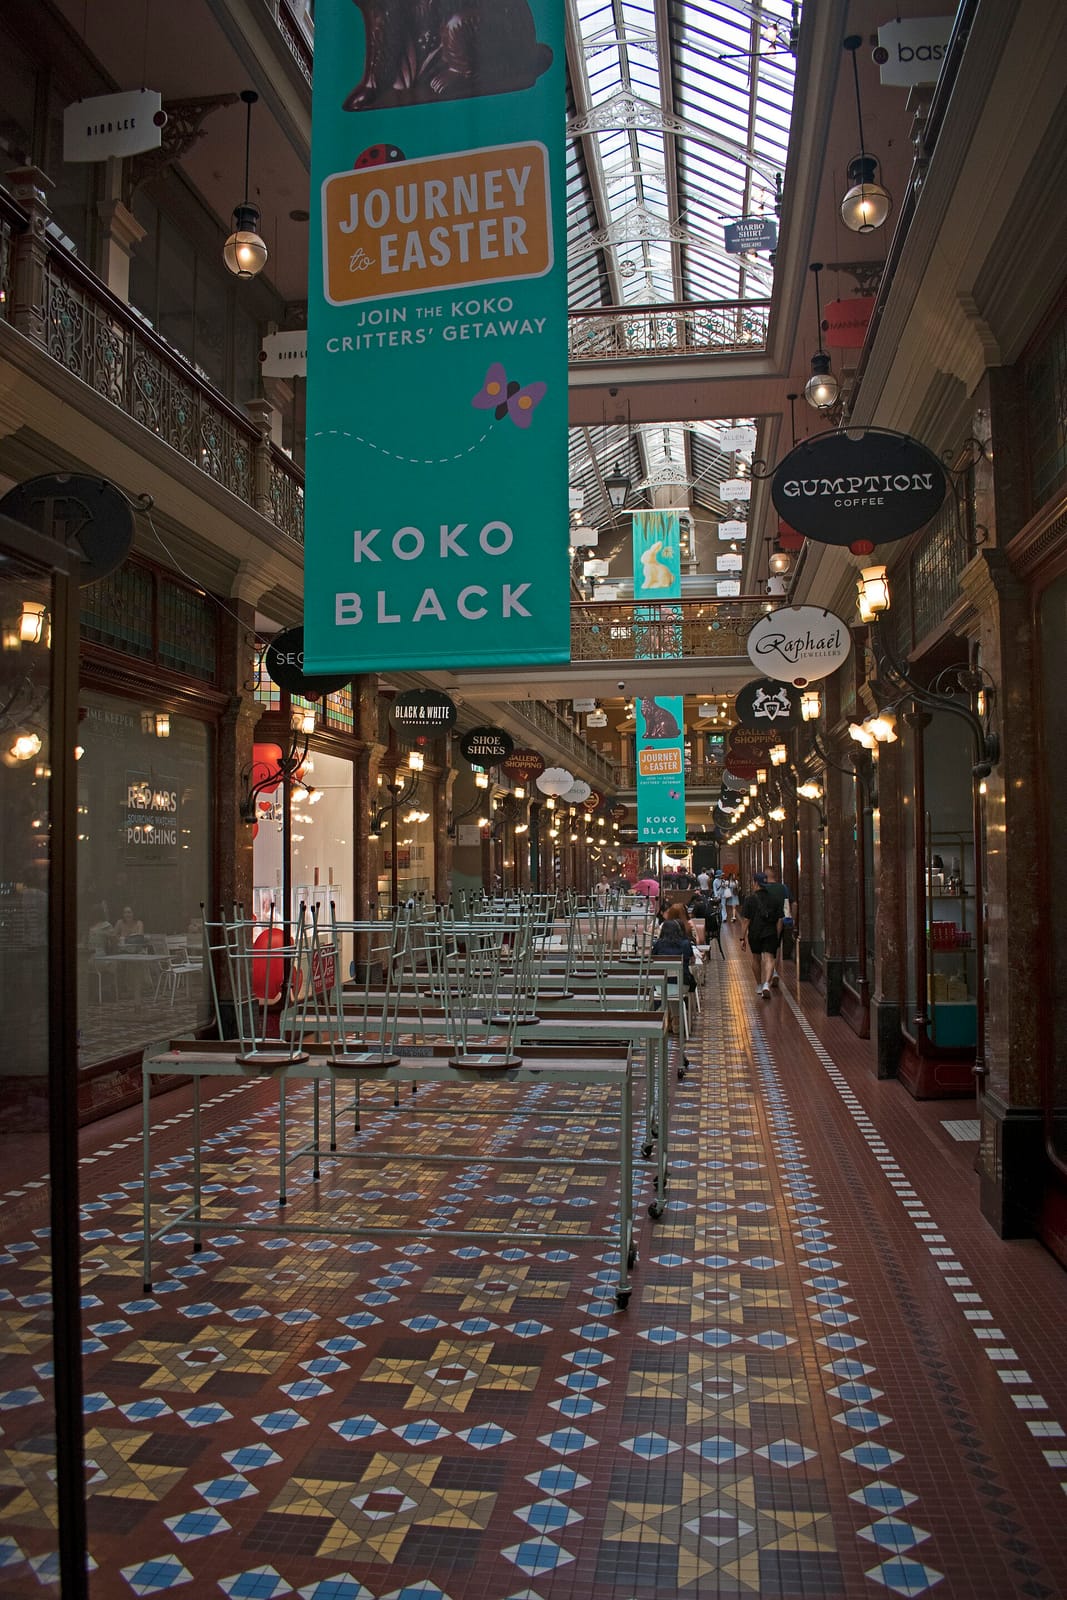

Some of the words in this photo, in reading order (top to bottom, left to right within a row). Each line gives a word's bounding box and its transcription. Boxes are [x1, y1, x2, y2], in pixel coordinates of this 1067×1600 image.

[117, 118, 136, 130] LEE
[339, 166, 531, 234] JOURNEY
[350, 248, 376, 272] to
[380, 216, 528, 275] EASTER
[357, 308, 407, 326] JOIN
[416, 306, 443, 319] THE
[451, 297, 513, 317] KOKO
[443, 318, 547, 341] GETAWAY
[783, 473, 933, 497] GUMPTION
[834, 497, 884, 507] COFFEE
[354, 521, 513, 563] KOKO
[335, 583, 532, 626] BLACK
[755, 629, 841, 663] Raphaël
[800, 650, 841, 659] JEWELLERS
[395, 705, 418, 718] BLACK
[419, 706, 426, 719] &
[427, 706, 449, 719] WHITE
[472, 735, 501, 745] SHOE
[467, 745, 505, 755] SHINES
[641, 752, 678, 763] JOURNEY
[504, 761, 542, 769] SHOPPING
[649, 761, 677, 771] EASTER
[128, 786, 177, 812] REPAIRS
[646, 816, 676, 824] KOKO
[127, 827, 177, 846] POLISHING
[643, 827, 680, 835] BLACK
